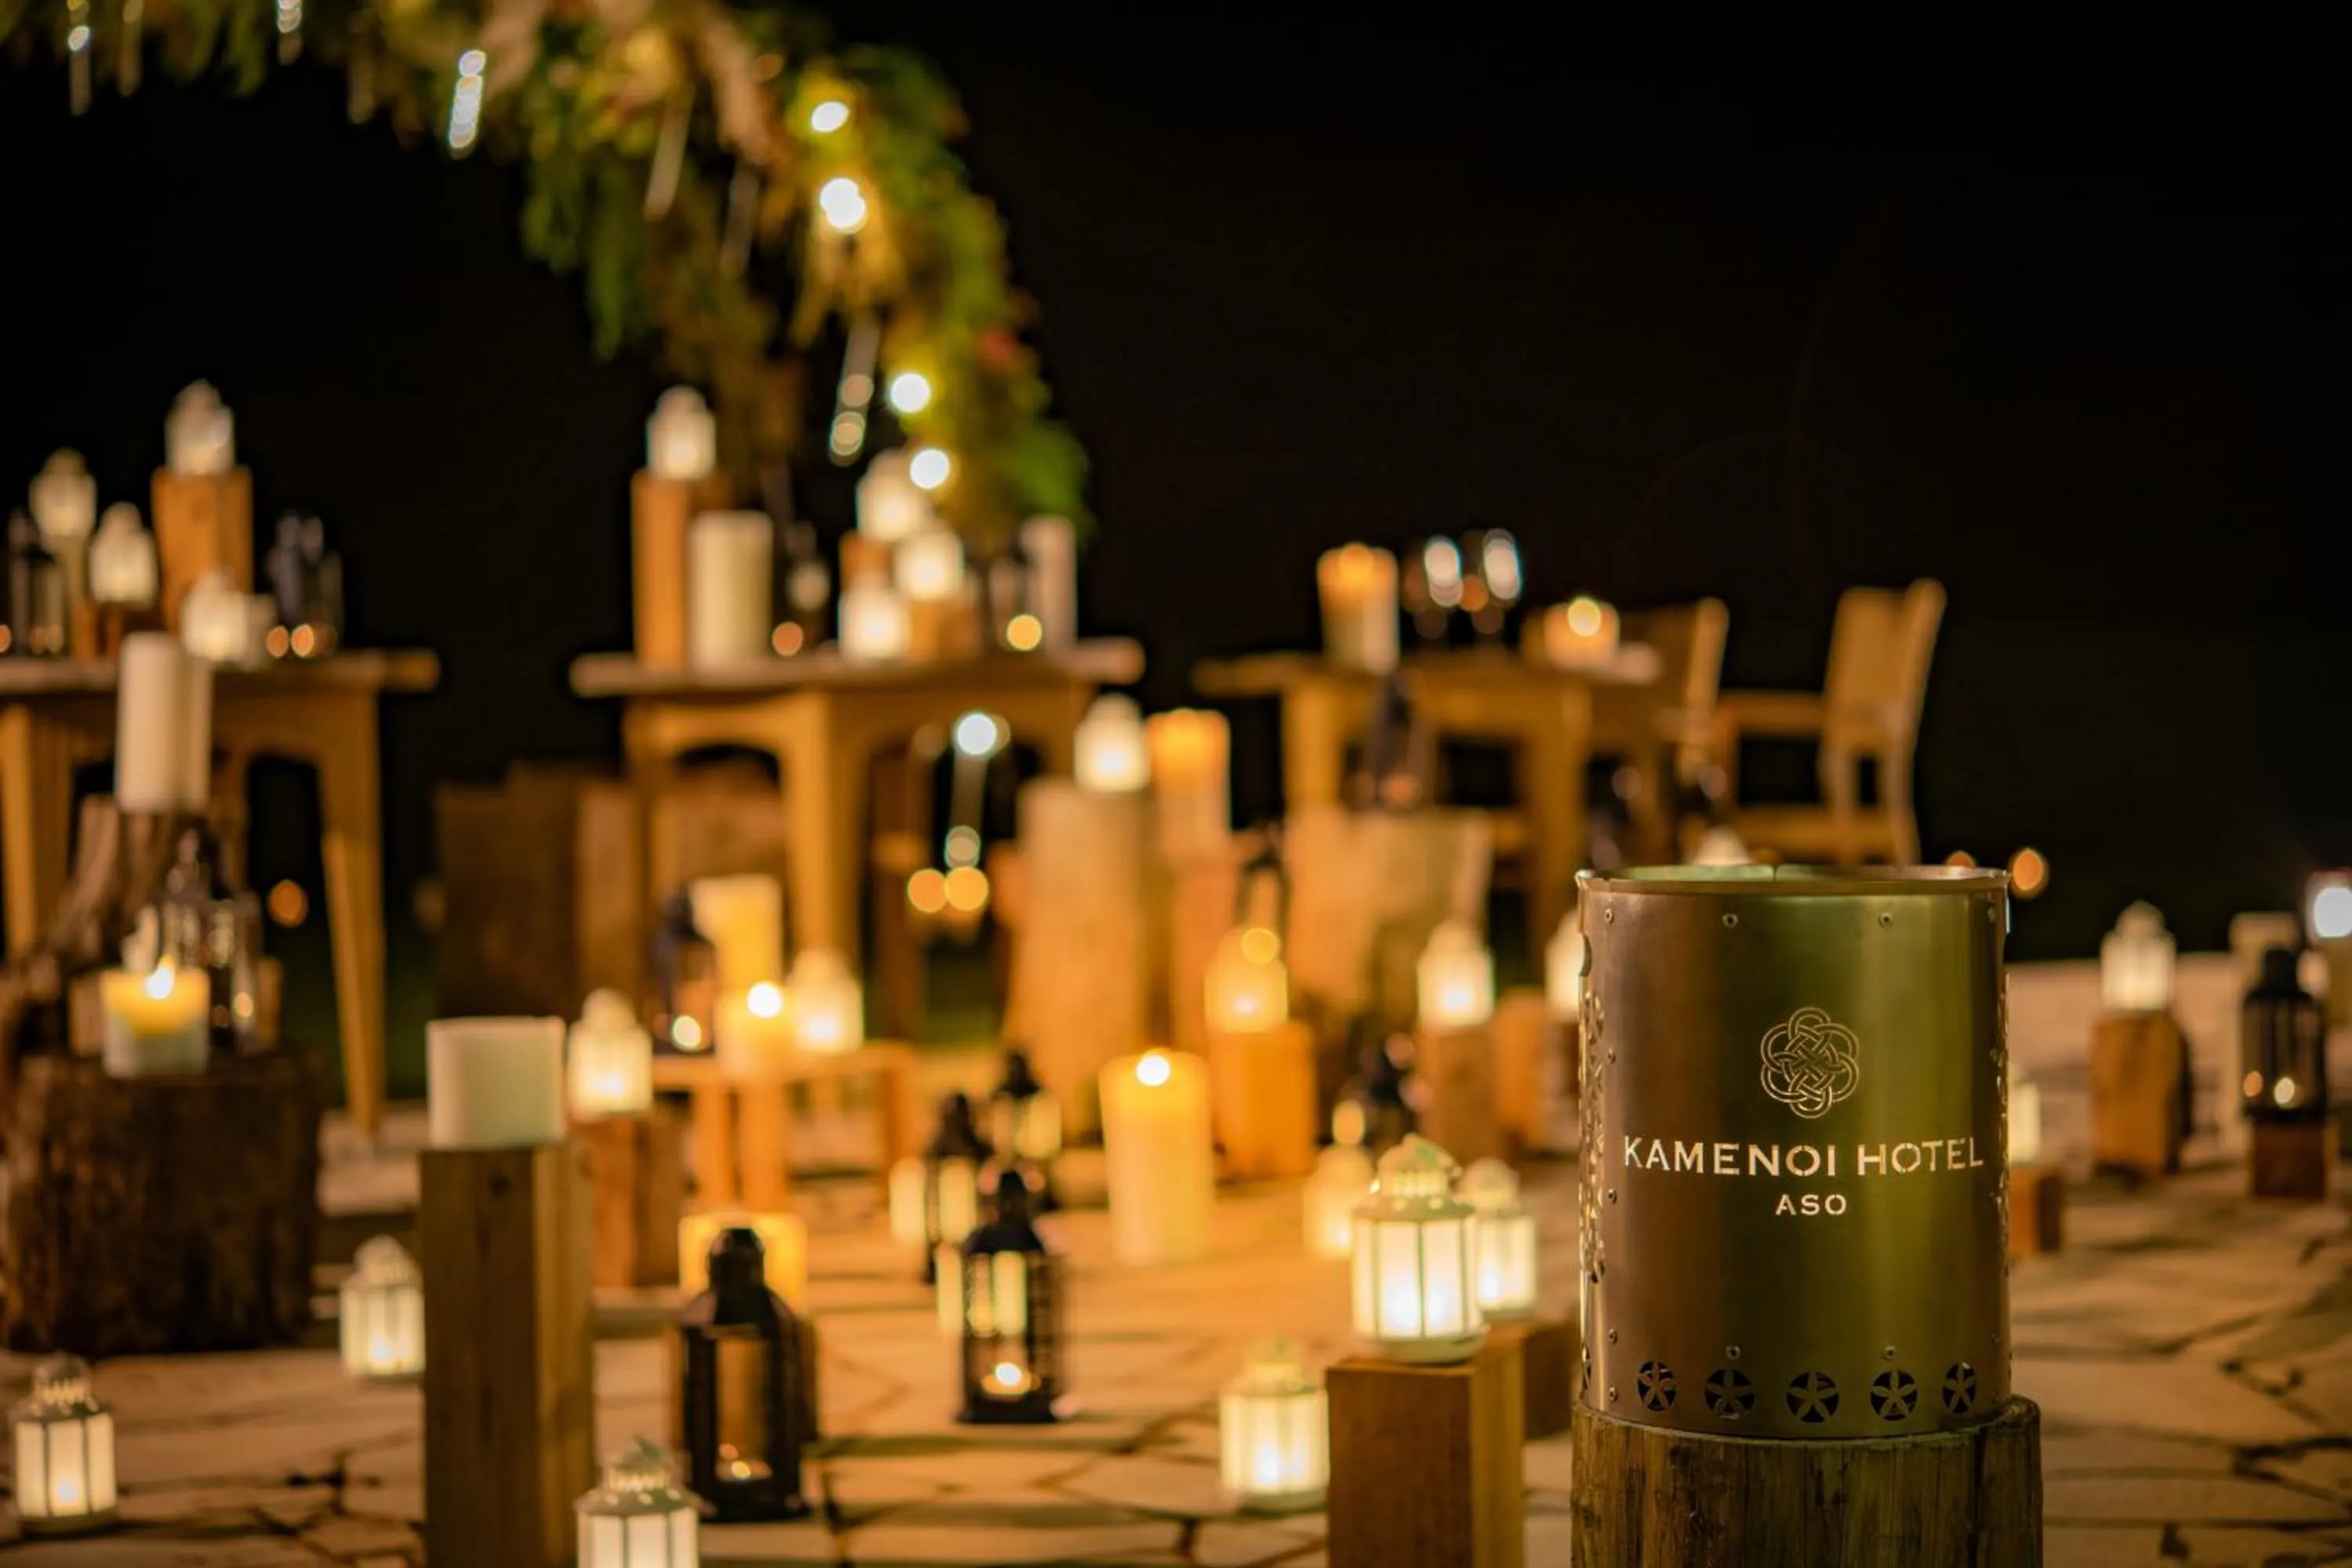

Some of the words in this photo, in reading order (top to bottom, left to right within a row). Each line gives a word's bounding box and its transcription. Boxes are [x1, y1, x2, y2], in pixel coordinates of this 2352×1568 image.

[1624, 1135, 1836, 1177] KAMENOI
[1857, 1137, 1984, 1175] HOTEL
[1775, 1193, 1847, 1216] ASO
